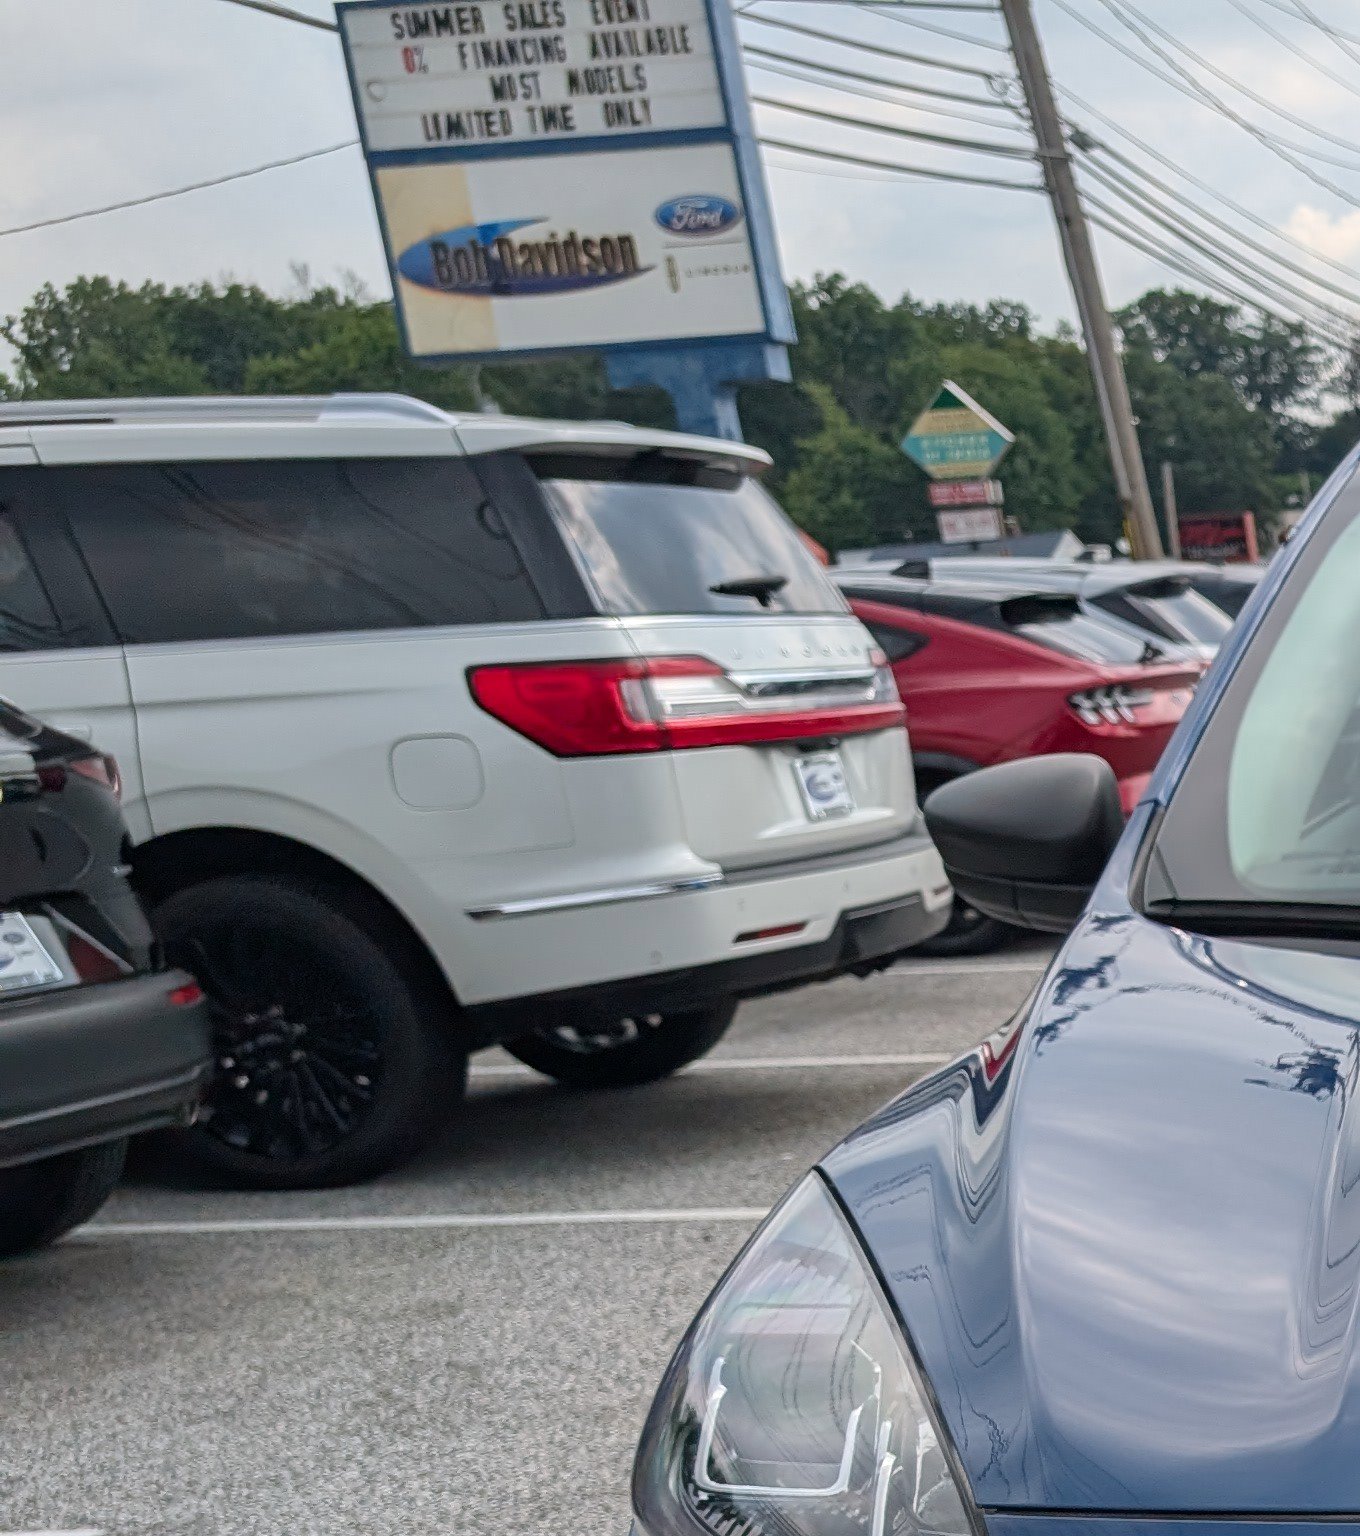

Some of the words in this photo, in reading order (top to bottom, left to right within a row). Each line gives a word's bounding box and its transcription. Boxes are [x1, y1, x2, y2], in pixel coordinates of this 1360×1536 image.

[390, 5, 486, 40] SUMMER
[505, 1, 567, 32] SALES
[457, 35, 567, 71] FINANCING
[588, 25, 693, 60] AVAILABLE
[489, 71, 541, 101] MOST
[567, 64, 648, 97] MODELS
[421, 109, 513, 142] LIMITED
[602, 98, 652, 129] ONLY
[431, 238, 491, 287] Bob
[496, 230, 640, 278] Davidson
